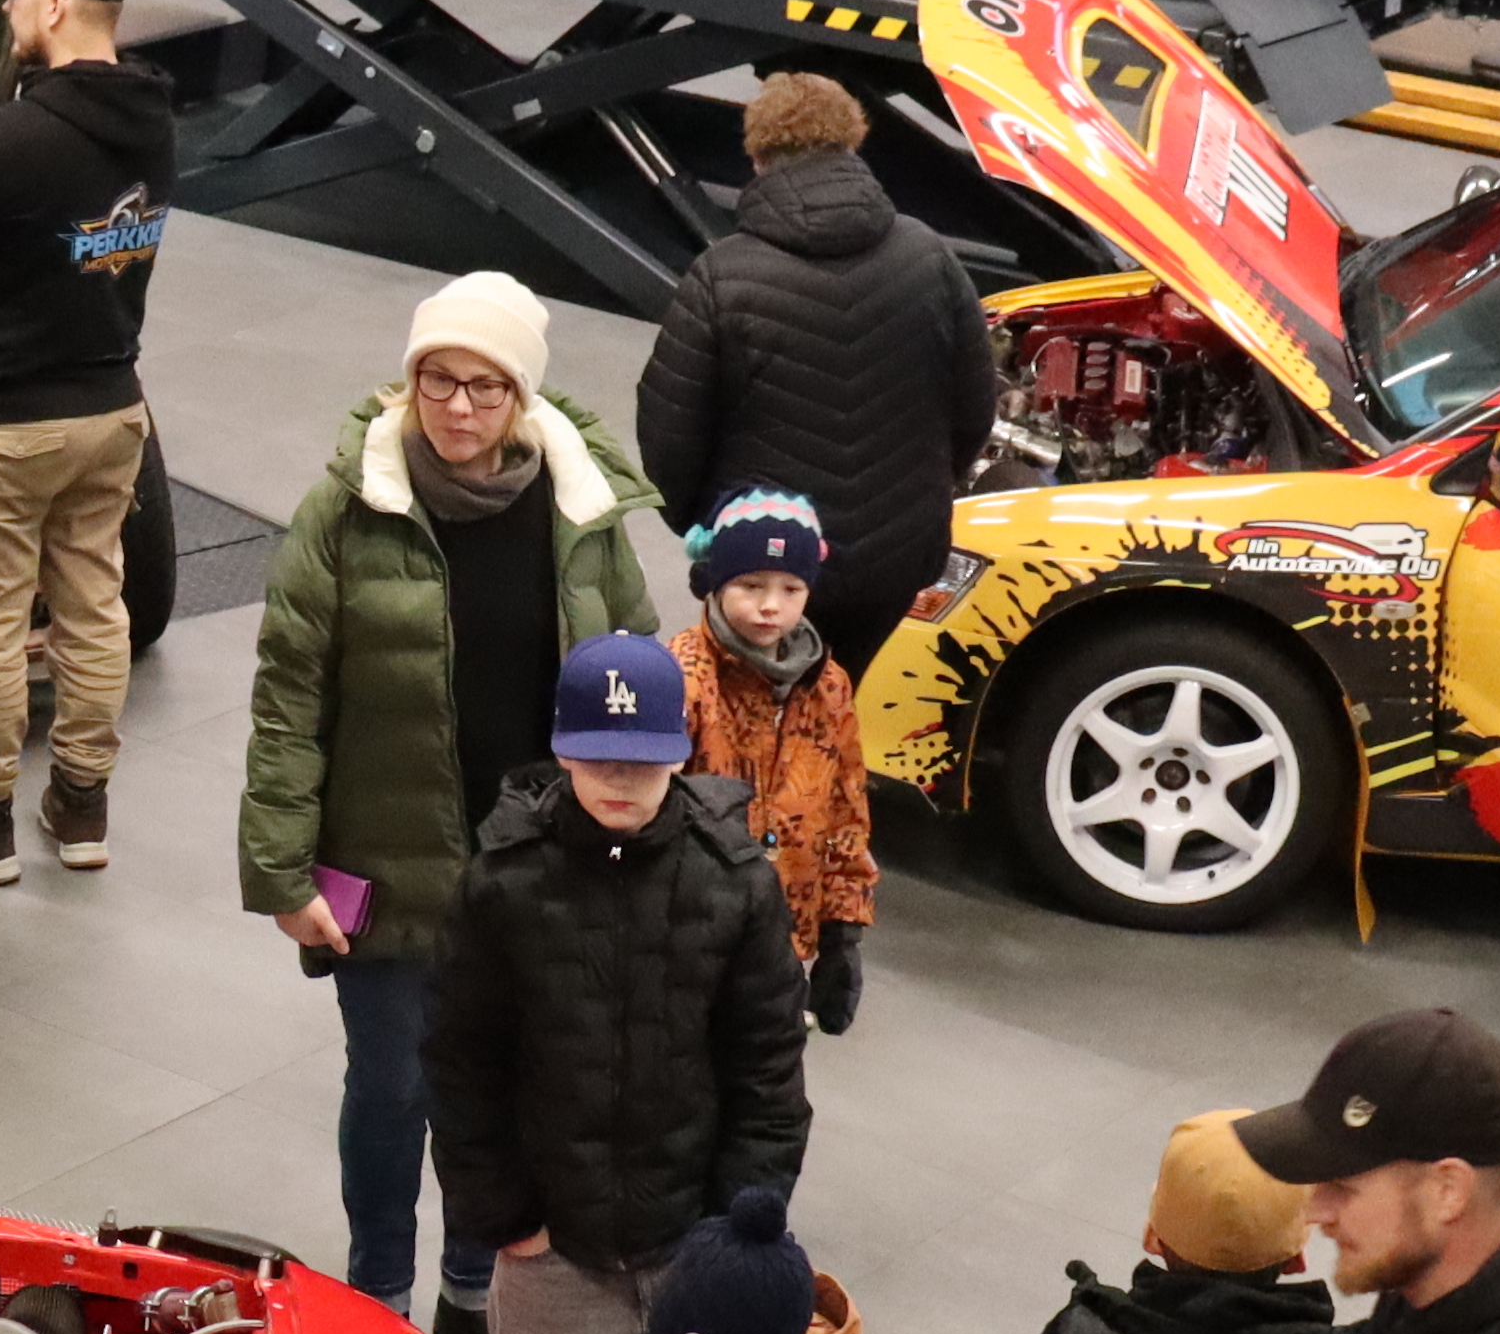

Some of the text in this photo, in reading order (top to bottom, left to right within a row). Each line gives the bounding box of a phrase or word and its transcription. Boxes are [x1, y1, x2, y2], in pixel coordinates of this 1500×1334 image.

[1227, 554, 1440, 580] Autotarvike Oy
[604, 669, 638, 715] LA
